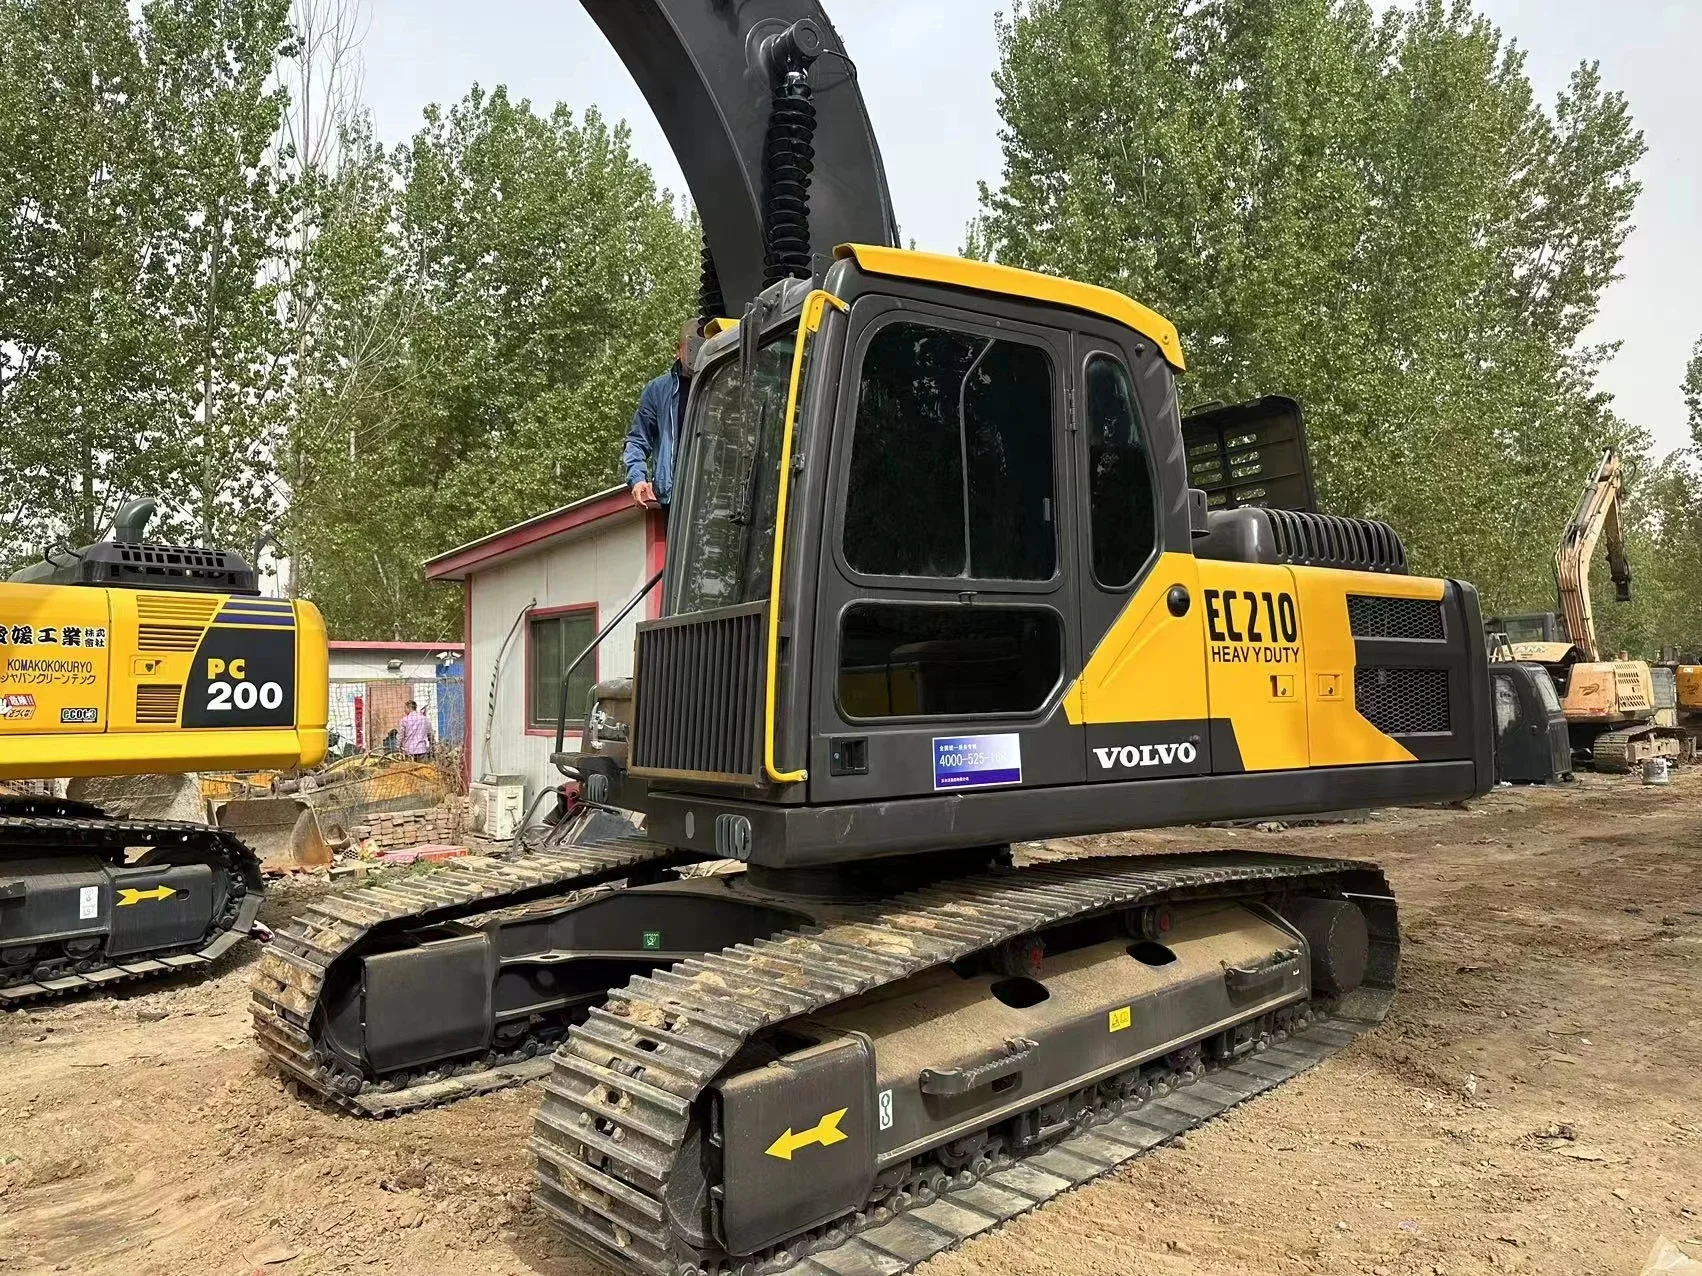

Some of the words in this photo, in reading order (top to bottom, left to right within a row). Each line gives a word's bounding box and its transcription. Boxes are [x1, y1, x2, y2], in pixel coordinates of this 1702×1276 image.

[1204, 590, 1297, 643] EC210
[207, 659, 245, 679] PC
[207, 681, 283, 710] 200
[1092, 742, 1197, 769] VOLVO
